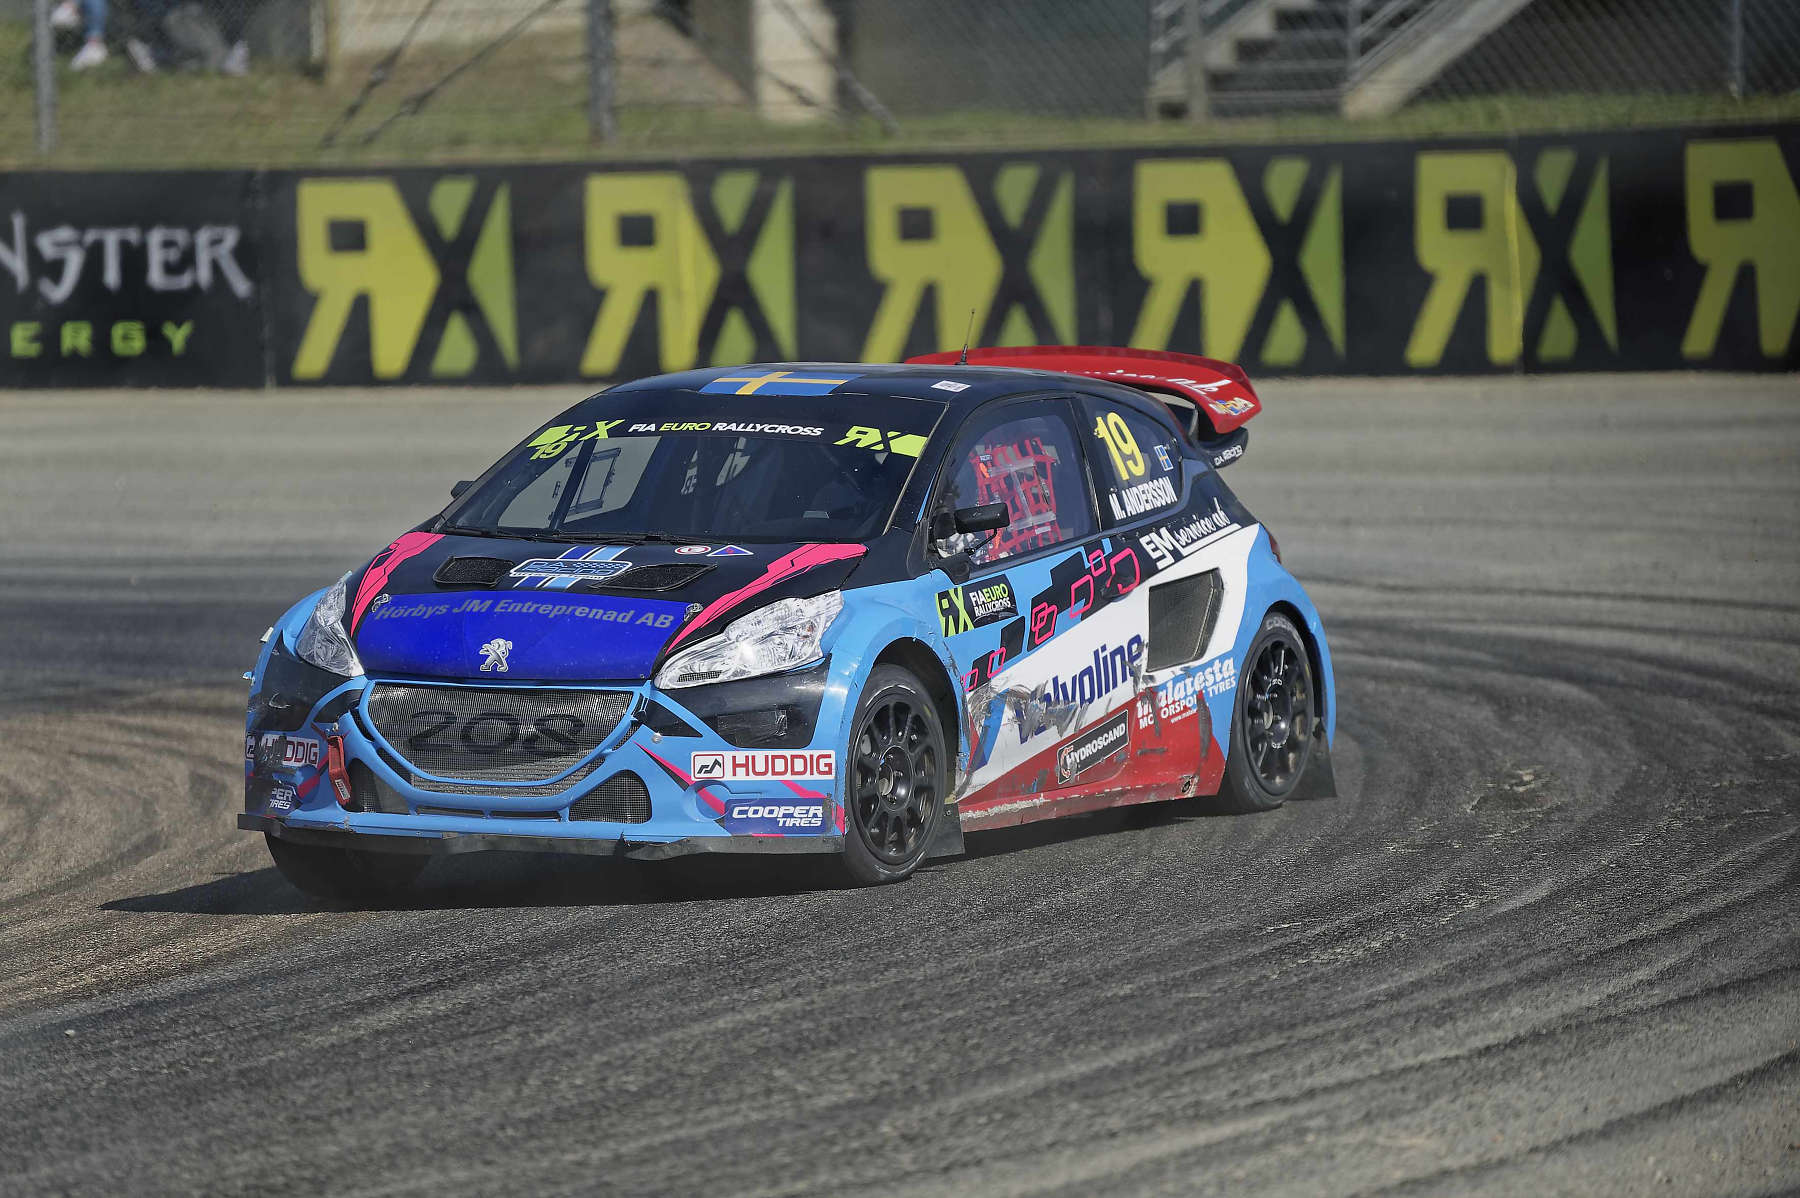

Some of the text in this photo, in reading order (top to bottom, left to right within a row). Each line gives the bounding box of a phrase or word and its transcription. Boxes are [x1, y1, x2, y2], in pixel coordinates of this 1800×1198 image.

[862, 166, 1076, 363] RX
[1132, 158, 1344, 366] RX
[1406, 149, 1617, 367] RX
[1682, 139, 1800, 358] R
[292, 179, 519, 380] RX
[580, 172, 795, 376] RX
[530, 440, 567, 460] 19
[628, 422, 824, 436] FIA EURO RALLYCROSS
[1094, 411, 1145, 481] 19
[1108, 476, 1178, 521] M. ANDERSSON
[1174, 513, 1216, 547] service
[375, 599, 675, 629] Hörbys JM Entreprenad AB
[974, 597, 1012, 617] RALLYCROSS
[1139, 692, 1200, 730] MOORSPO
[1207, 674, 1236, 698] TYRES
[408, 710, 586, 757] 208
[1066, 722, 1126, 766] HYDROSCAND
[731, 754, 833, 777] HUDDIG
[732, 806, 823, 819] COOPER
[777, 817, 823, 827] TIRES
